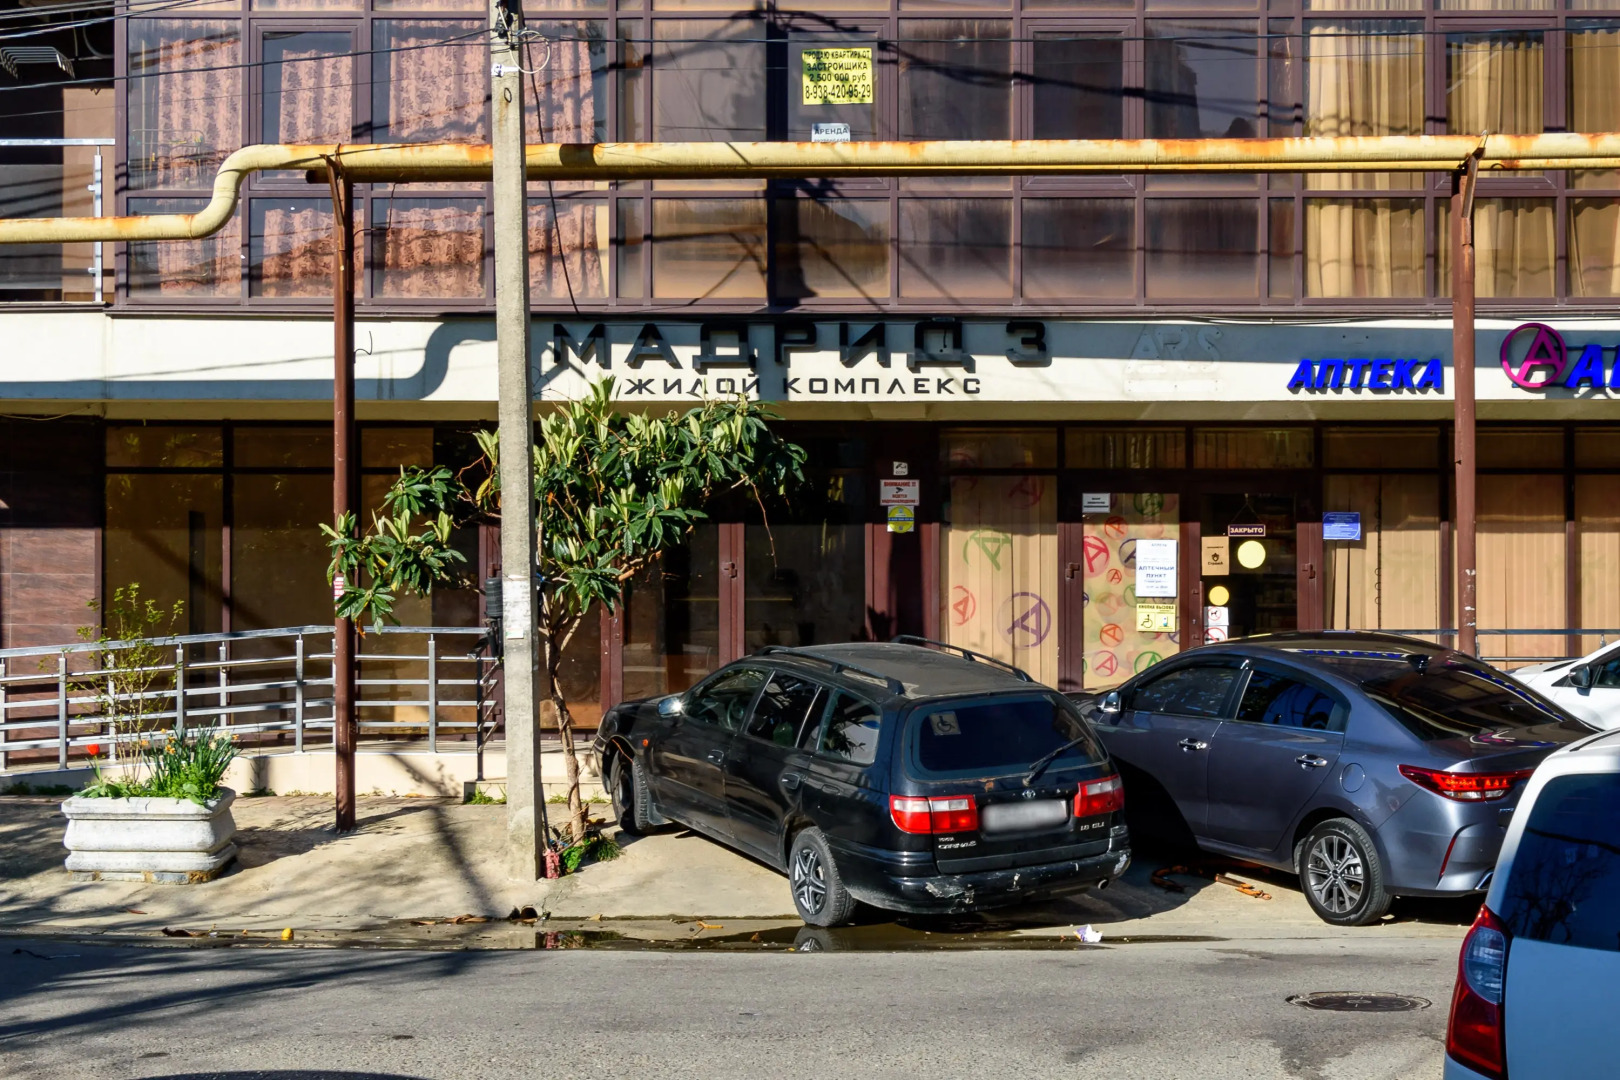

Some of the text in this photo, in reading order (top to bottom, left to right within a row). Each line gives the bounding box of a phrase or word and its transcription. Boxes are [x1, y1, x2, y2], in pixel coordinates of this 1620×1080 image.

[809, 73, 867, 83] 2 500 000 руб
[814, 127, 848, 135] АРЕНДА
[553, 321, 1050, 371] МАДРИД 3
[624, 372, 981, 395] ЖИЛОЙ КОМПЛЕКС
[1287, 358, 1442, 389] АПТЕКА
